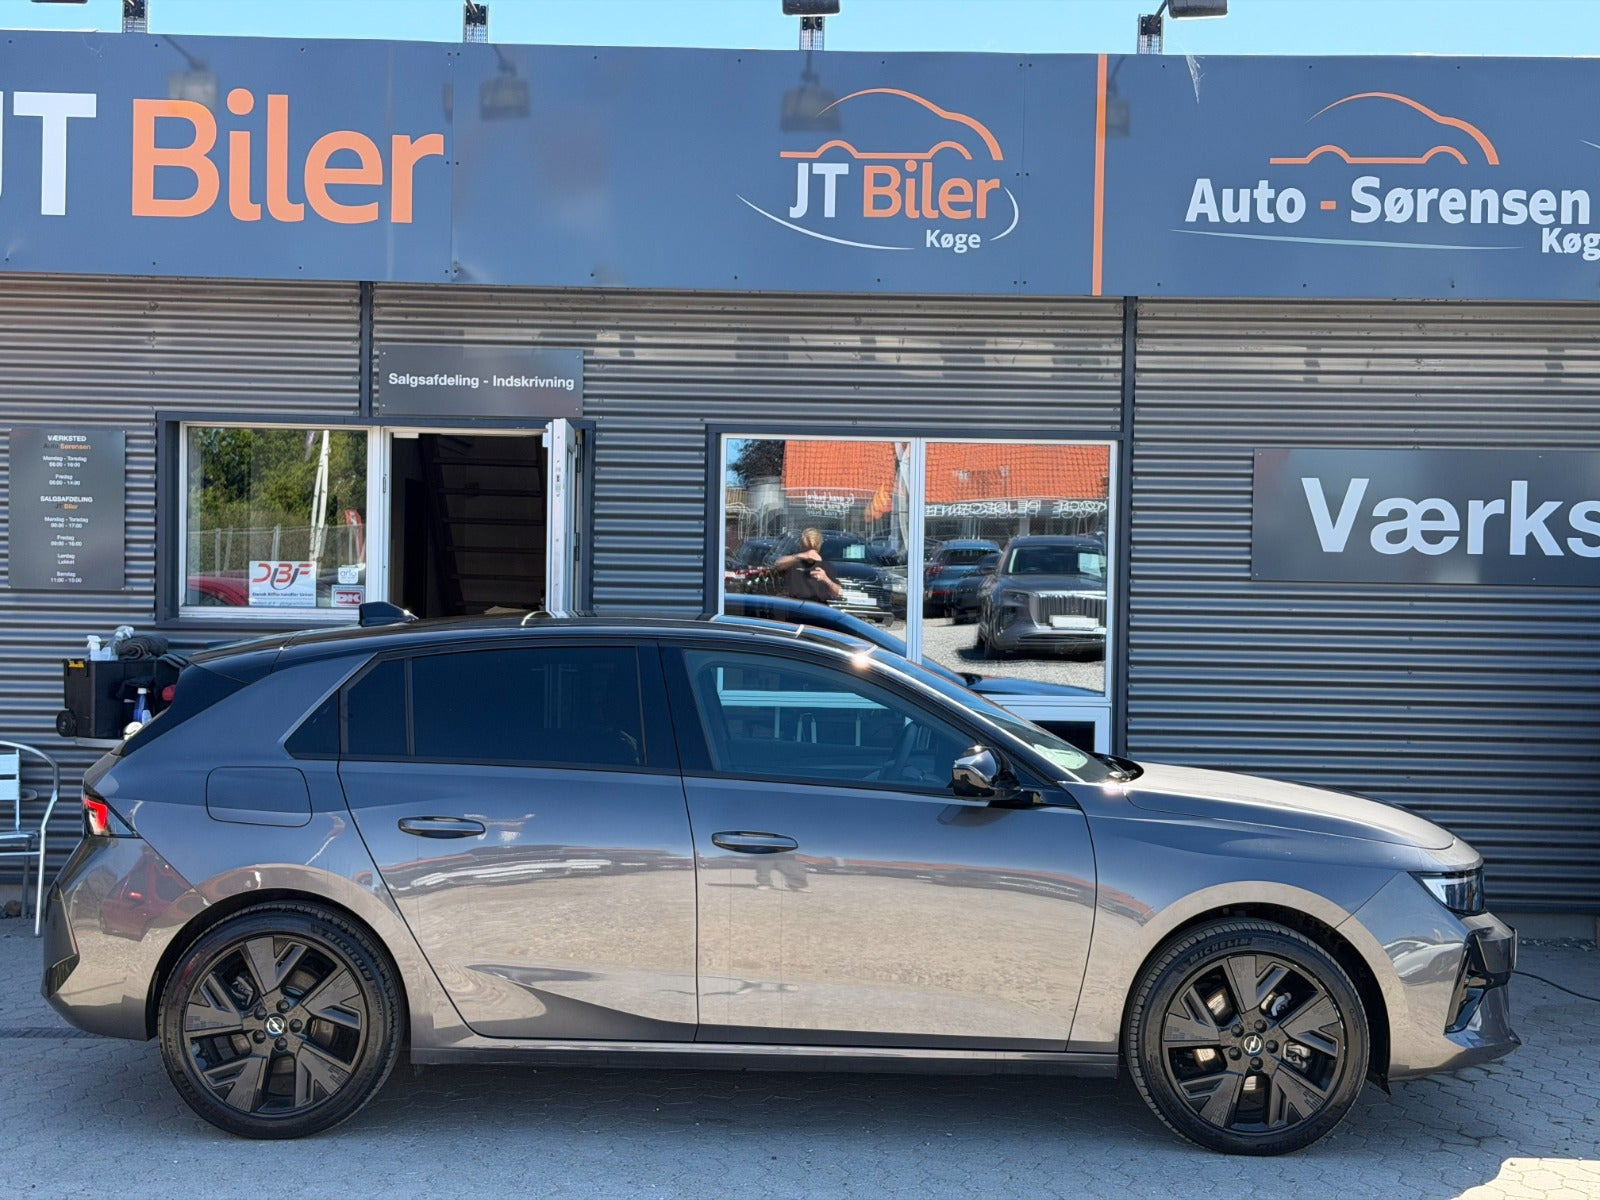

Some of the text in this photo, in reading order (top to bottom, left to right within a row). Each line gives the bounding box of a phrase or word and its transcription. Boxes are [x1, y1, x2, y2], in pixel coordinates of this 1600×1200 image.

[0, 88, 444, 224] T Biler
[789, 160, 1000, 220] JT Biler
[1185, 175, 1591, 225] Auto - Sørensen
[925, 229, 981, 254] Køge
[388, 372, 480, 389] Salgsafdeling
[492, 374, 575, 391] Indskrivning
[47, 434, 87, 442] VÆRKSTED
[40, 495, 93, 503] SALGSAFDELING
[1301, 477, 1600, 559] Værks
[323, 931, 373, 981] MICHELIN
[1189, 937, 1252, 963] MICHELIN
